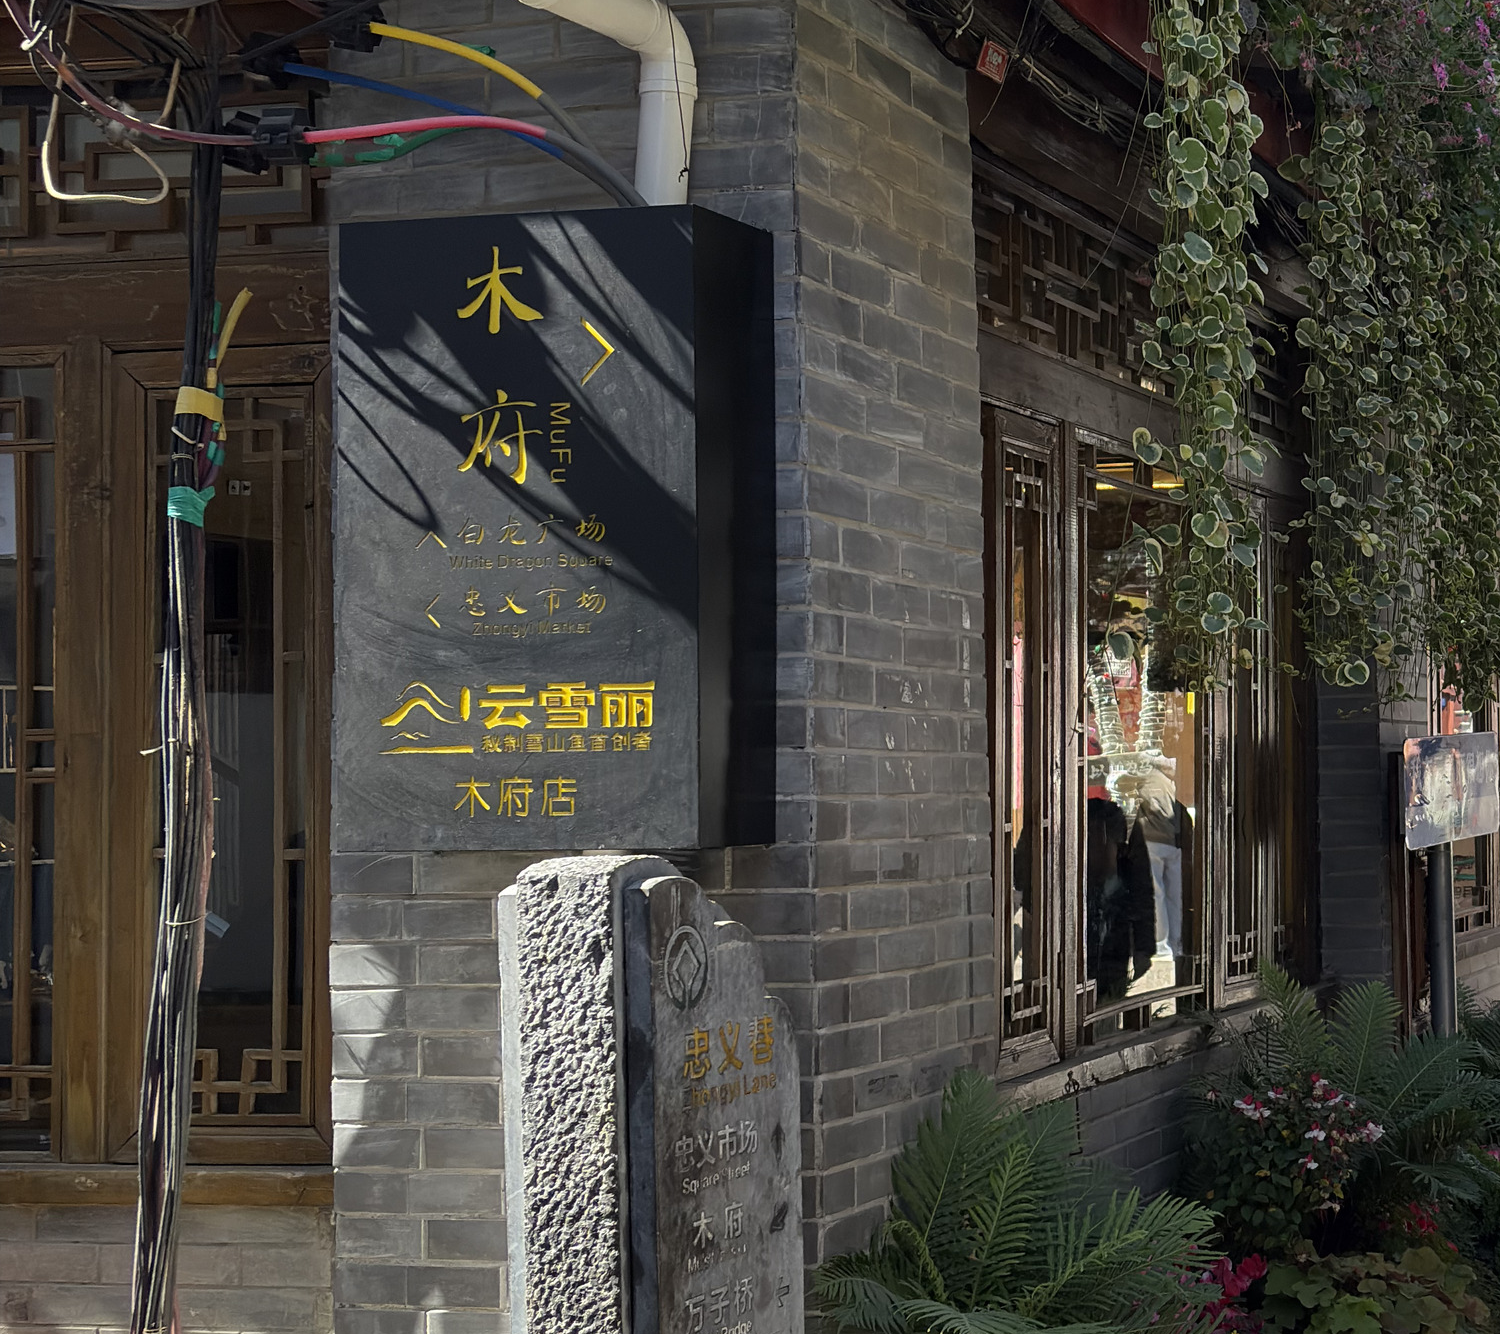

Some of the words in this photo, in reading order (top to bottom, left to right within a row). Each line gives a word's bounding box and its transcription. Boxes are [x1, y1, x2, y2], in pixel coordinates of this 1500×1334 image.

[457, 245, 544, 485] 木府
[549, 402, 572, 484] MuFu
[456, 513, 606, 546] 白龙广场
[449, 554, 494, 570] White
[497, 554, 552, 572] Dragon
[557, 553, 614, 569] Square
[459, 584, 607, 617] 忠义市场
[472, 621, 534, 639] Zhongyi
[538, 620, 592, 635] Market
[478, 681, 656, 730] 云雪丽
[454, 775, 578, 818] 木府店
[683, 1015, 775, 1079] 忠义巷
[743, 1072, 777, 1097] Lane
[674, 1120, 759, 1173] 忠义市场
[693, 1201, 744, 1249] 木府
